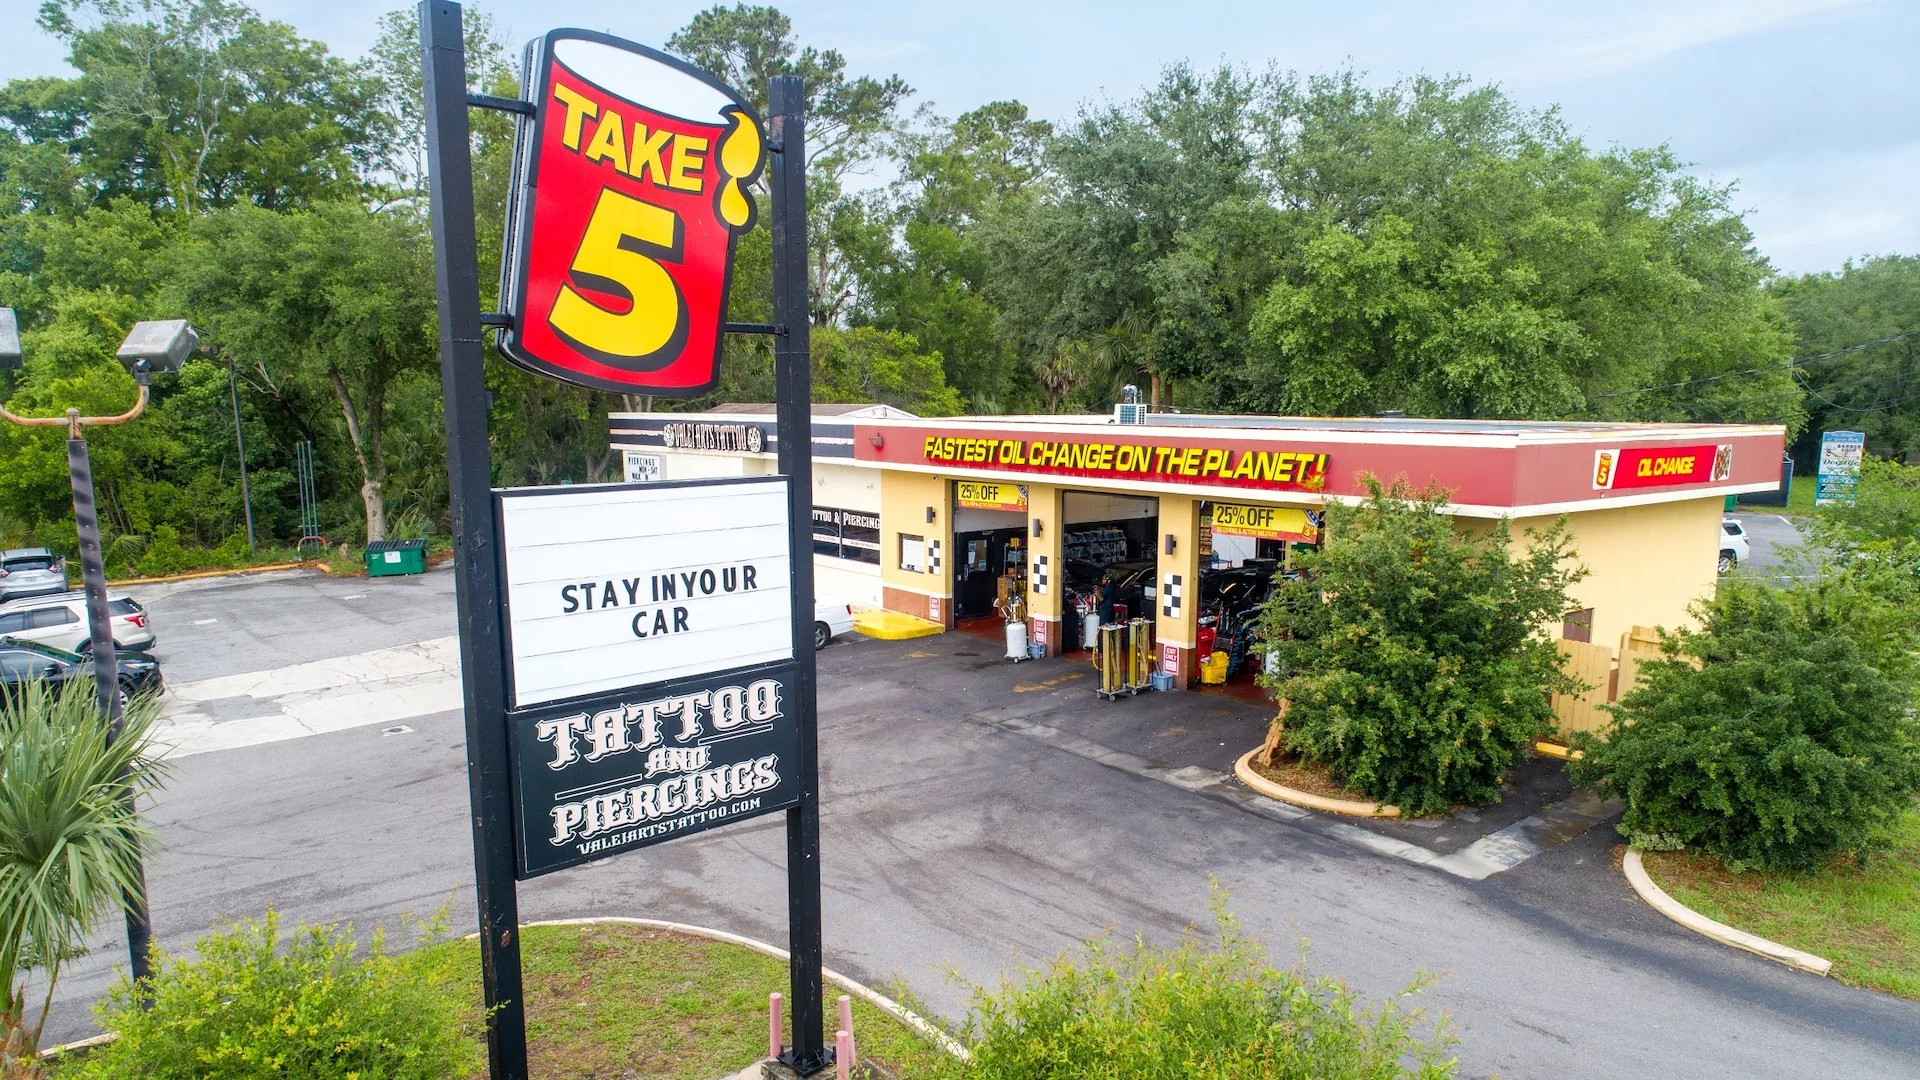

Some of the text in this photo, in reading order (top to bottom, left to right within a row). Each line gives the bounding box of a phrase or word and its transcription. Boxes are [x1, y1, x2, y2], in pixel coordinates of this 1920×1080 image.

[554, 80, 709, 196] TAKE
[547, 185, 690, 373] 5
[628, 456, 655, 467] PIERCINGS
[923, 436, 999, 464] FASTEST
[999, 439, 1027, 465] OIL
[1028, 440, 1115, 470] CHANGE
[1115, 445, 1151, 473] ON
[1154, 446, 1203, 476] THE
[1637, 456, 1696, 477] OIL CHANGE
[1597, 466, 1608, 484] 5
[960, 484, 999, 501] 25% OFF
[812, 509, 832, 522] TTOO
[834, 511, 840, 525] &
[1216, 505, 1275, 527] 25% OFF
[561, 577, 641, 613] STAY
[631, 606, 690, 638] CAR
[1165, 653, 1177, 661] ONLY
[536, 678, 784, 770] TATTOO
[644, 744, 712, 778] AND
[548, 753, 782, 847] PIERCINGS
[576, 797, 761, 855] VALEIARTSTATTOO.COM
